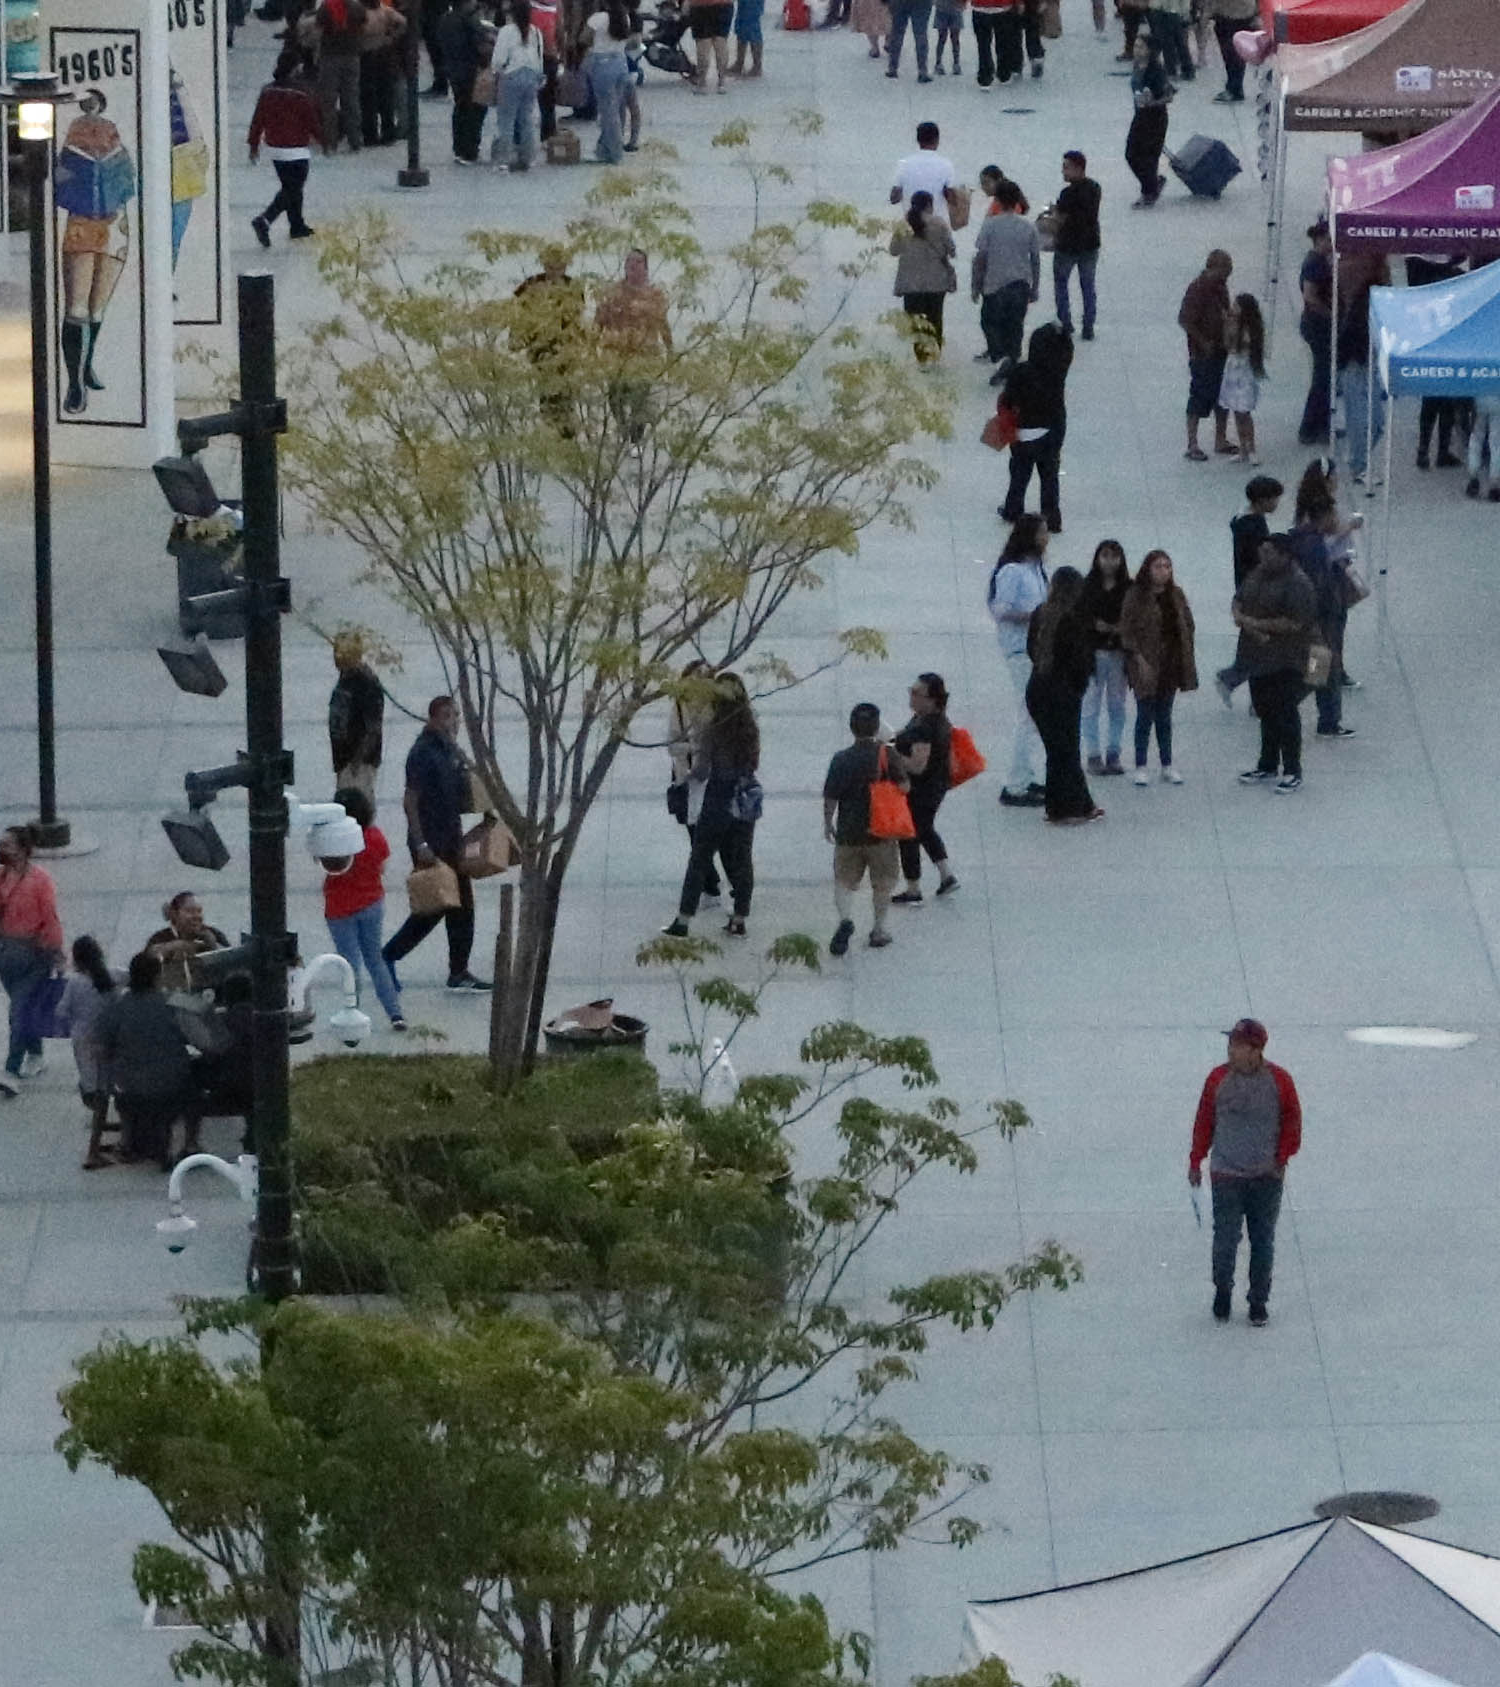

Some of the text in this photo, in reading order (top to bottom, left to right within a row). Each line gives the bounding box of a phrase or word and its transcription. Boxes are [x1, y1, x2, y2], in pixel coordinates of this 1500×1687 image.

[57, 44, 134, 85] 1960'S
[1347, 226, 1397, 239] CAREER
[1399, 226, 1409, 239] &
[1411, 226, 1478, 240] ACADEMIC
[1400, 366, 1455, 379] CAREER
[1457, 366, 1468, 379] &
